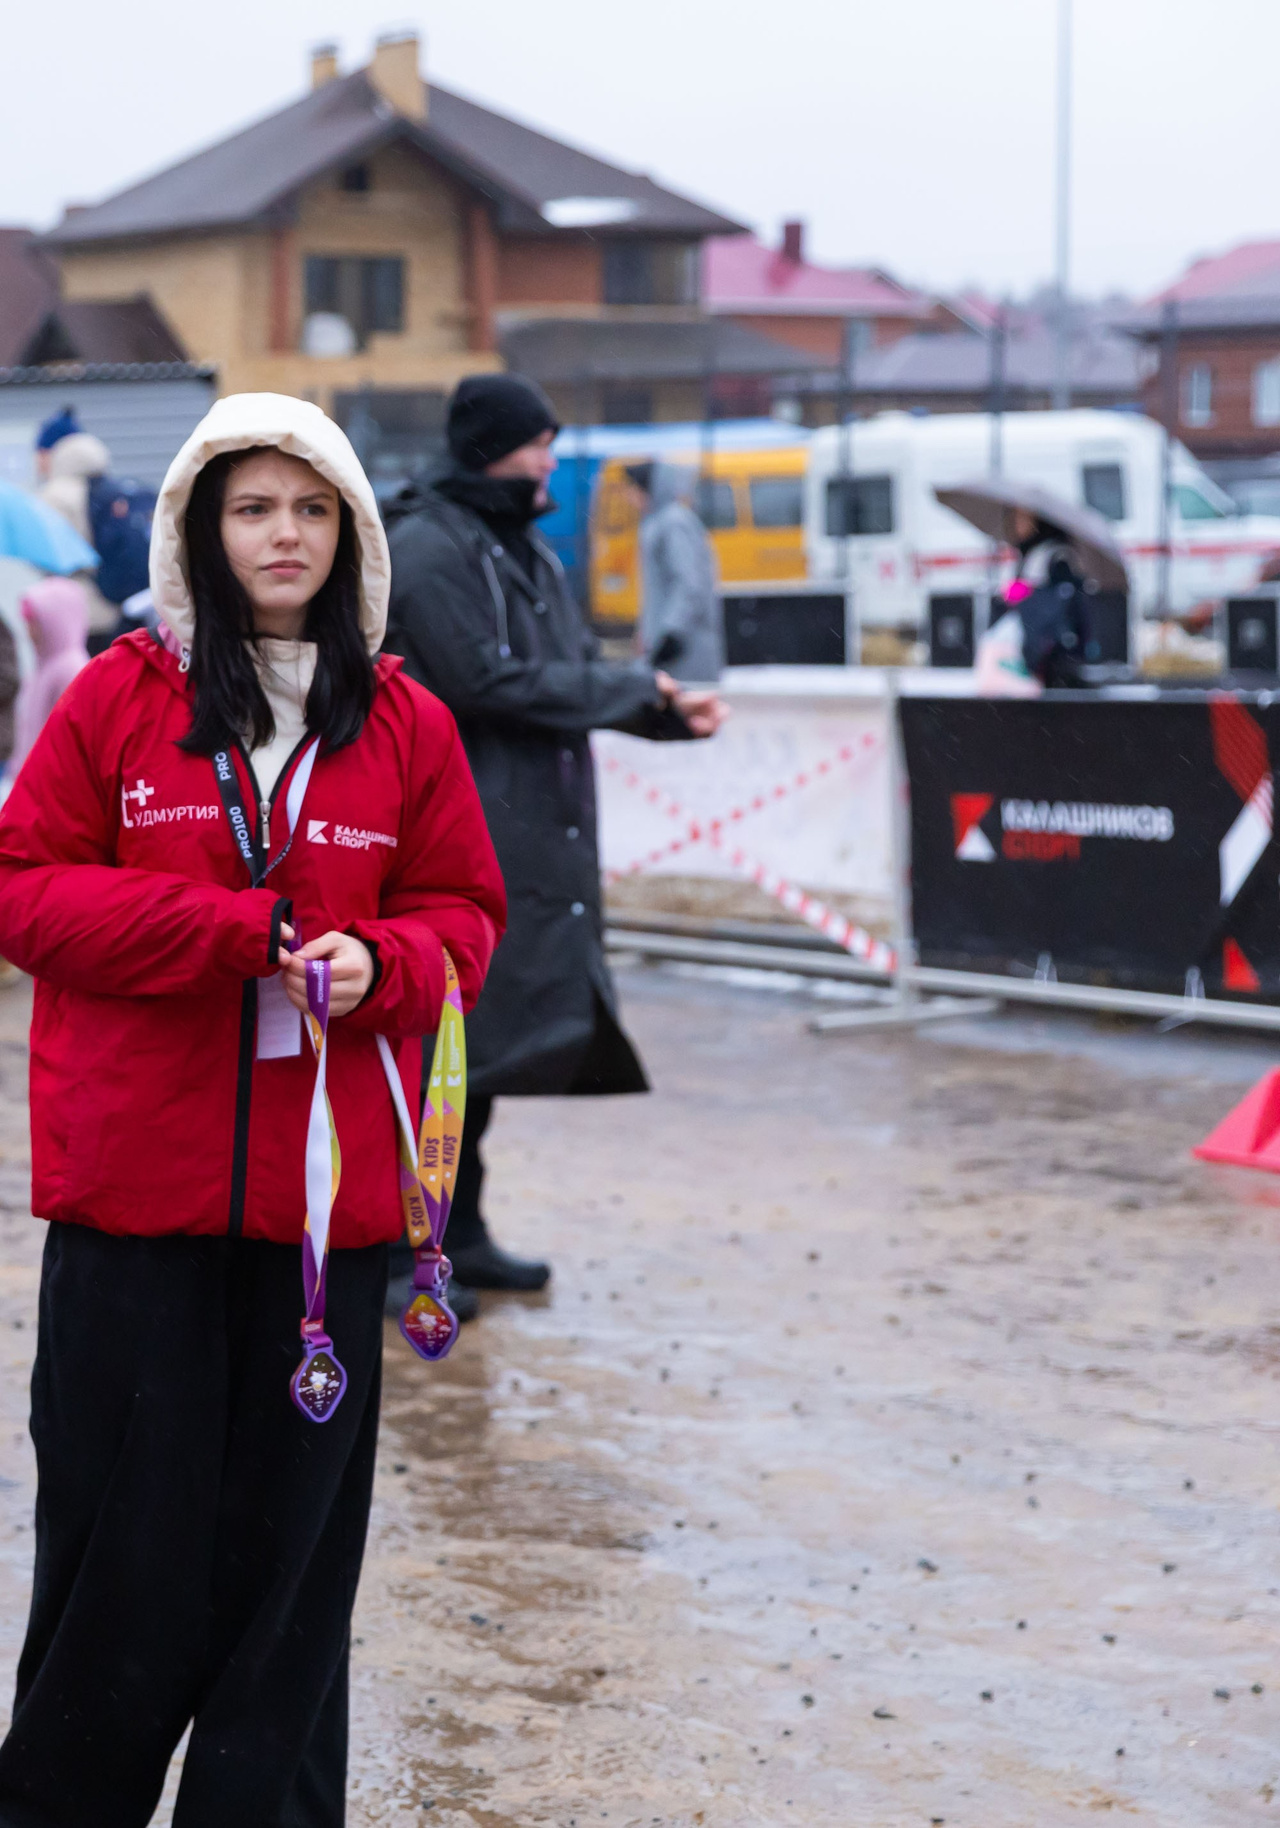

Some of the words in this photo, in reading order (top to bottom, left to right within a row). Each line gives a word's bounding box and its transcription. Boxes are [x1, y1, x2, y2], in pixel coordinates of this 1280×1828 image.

[134, 805, 219, 828] УДМУРТИЯ
[229, 806, 253, 859] PRO100
[1001, 799, 1175, 842] КАЛАШНИКОВ
[333, 834, 372, 851] СПОРТ
[423, 1137, 440, 1168] KIDS
[442, 1134, 458, 1166] KIDS
[409, 1196, 425, 1228] KIDS
